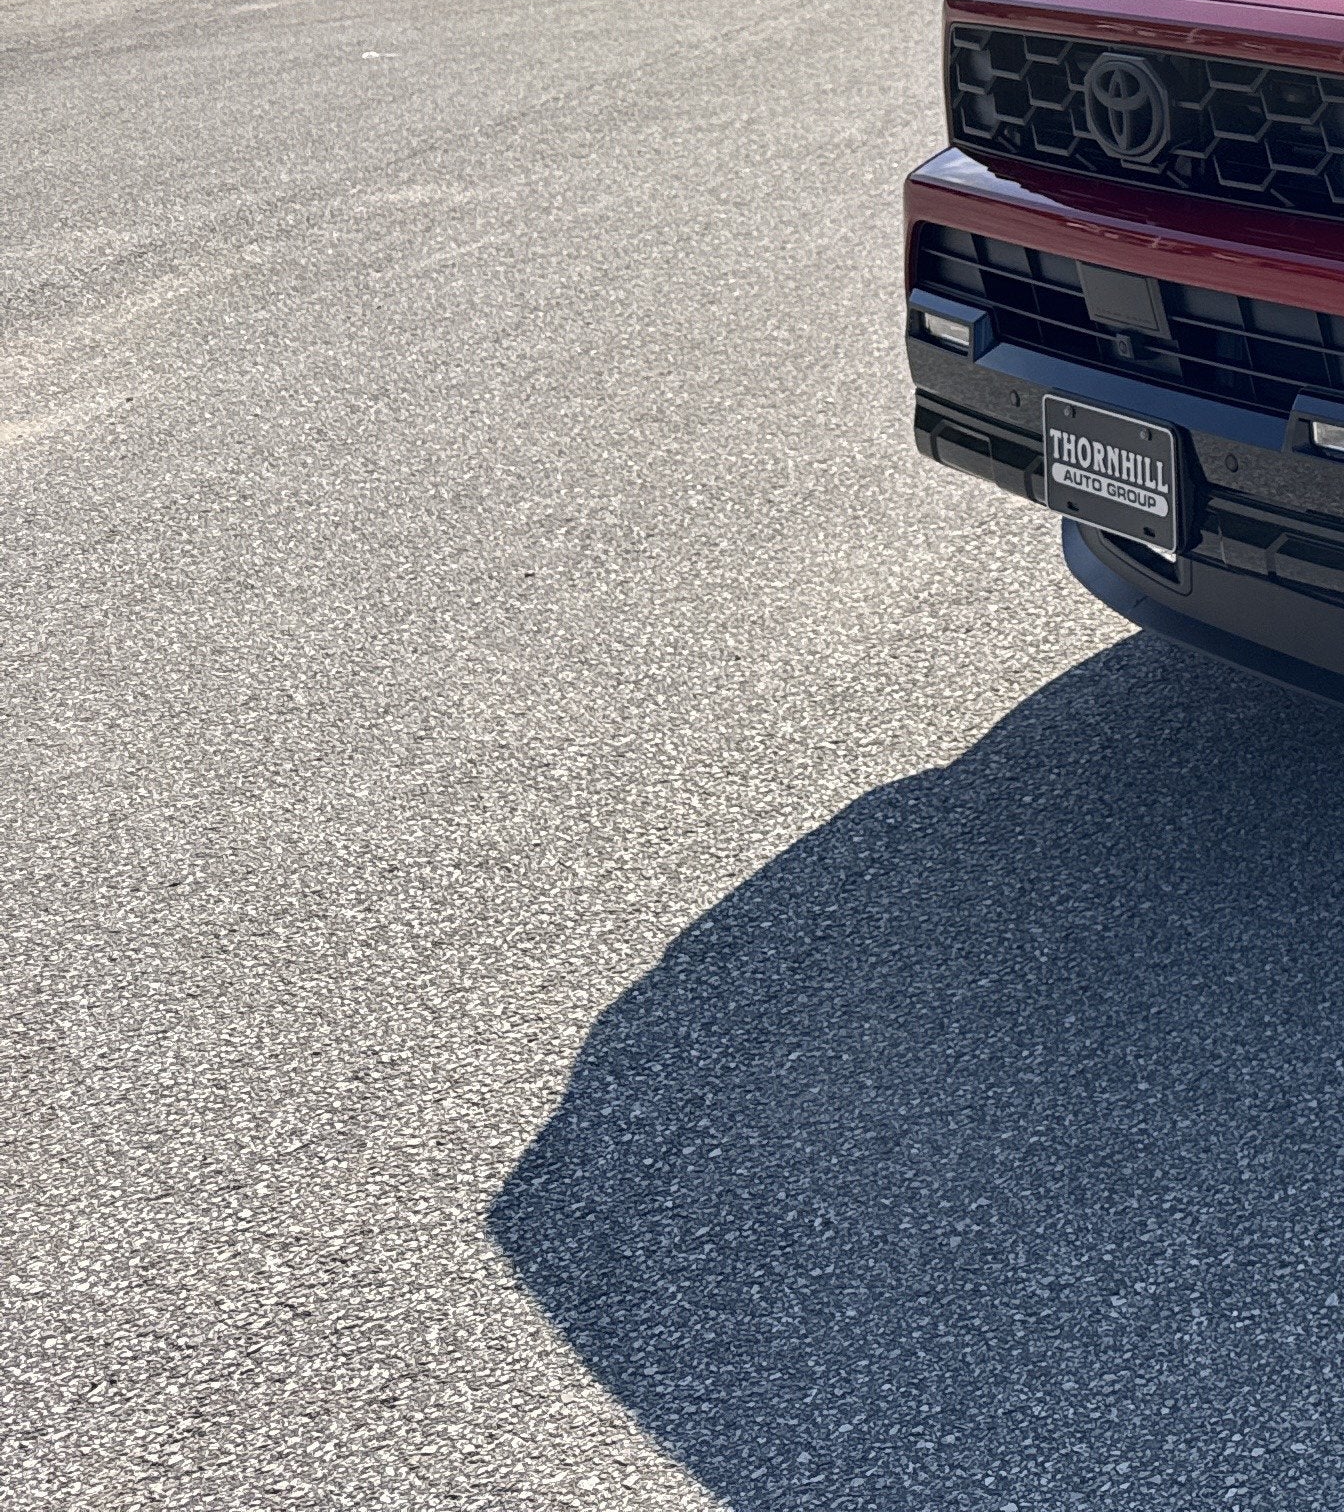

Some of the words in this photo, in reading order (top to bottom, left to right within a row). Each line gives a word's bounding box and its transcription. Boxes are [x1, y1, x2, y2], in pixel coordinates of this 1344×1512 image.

[1050, 429, 1168, 493] THORNHILL
[1064, 469, 1103, 492] AUTO
[1107, 482, 1157, 509] GROUP
